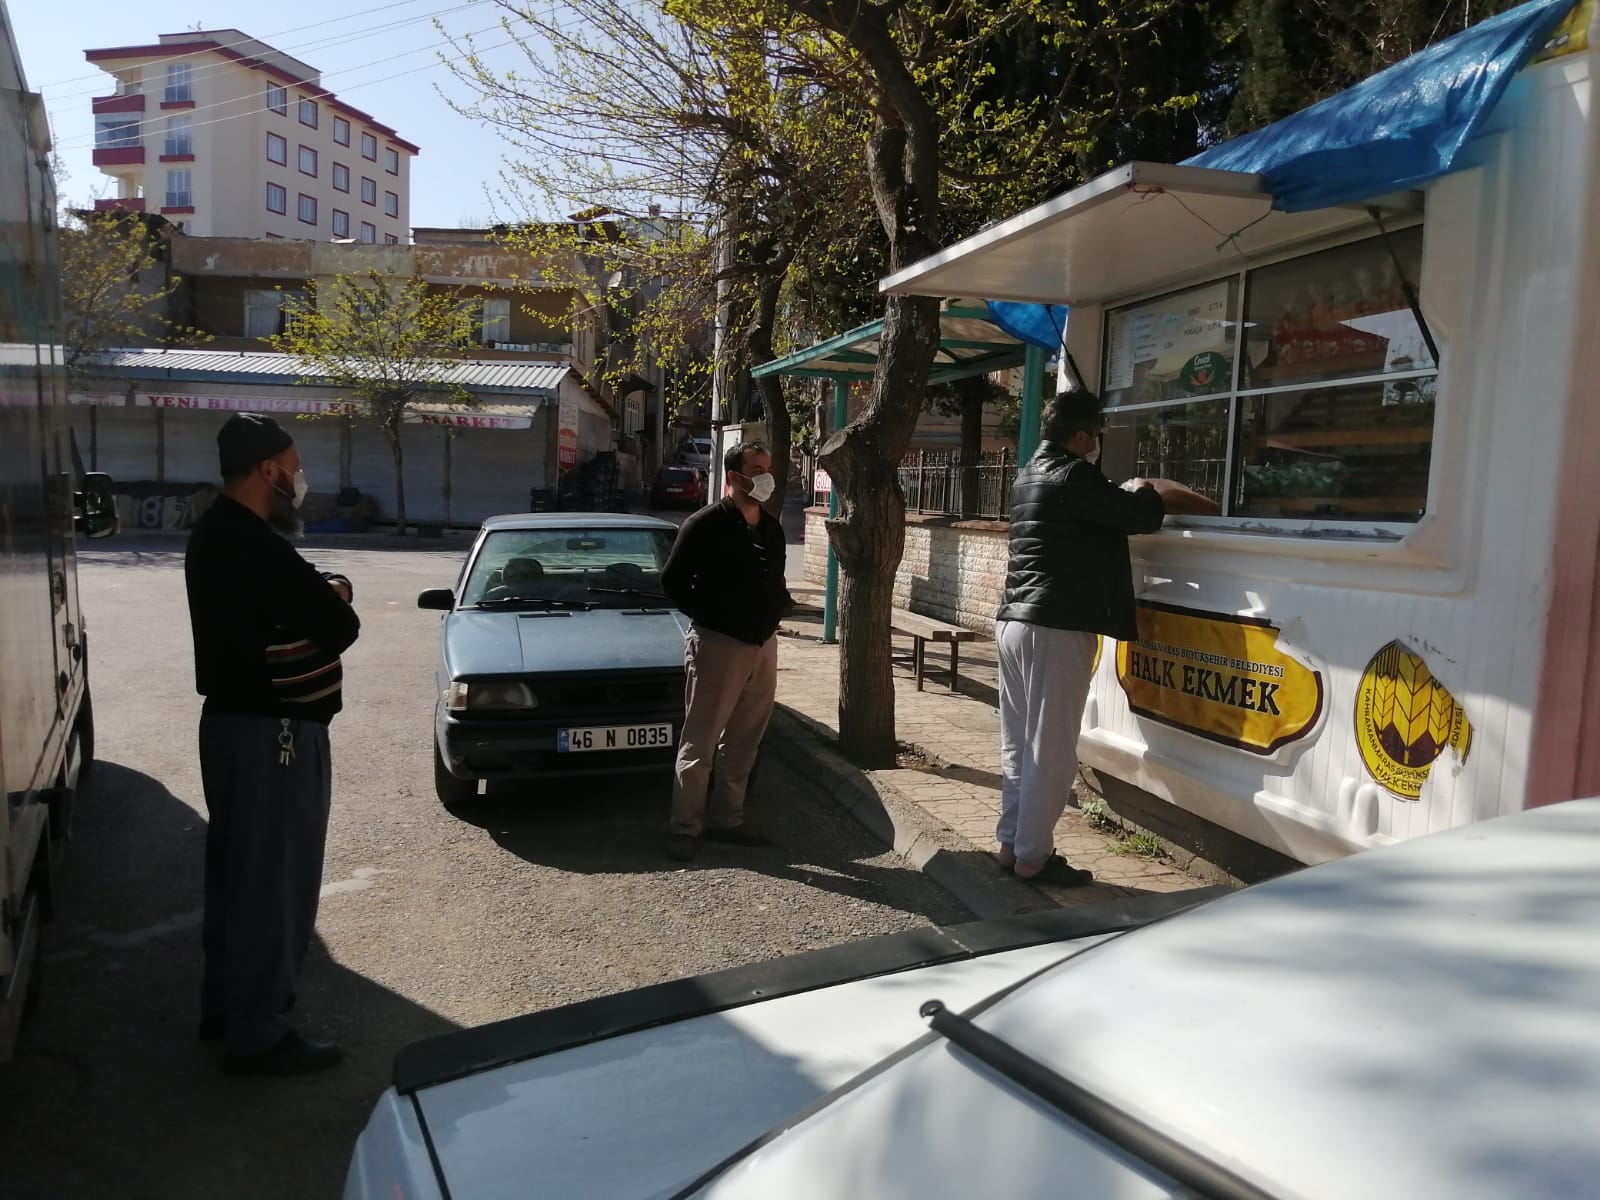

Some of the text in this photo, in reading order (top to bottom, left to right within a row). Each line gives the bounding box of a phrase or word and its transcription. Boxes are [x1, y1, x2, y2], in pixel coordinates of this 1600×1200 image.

[1130, 651, 1281, 716] HALK EKMEK
[572, 726, 668, 749] 46 N 0835
